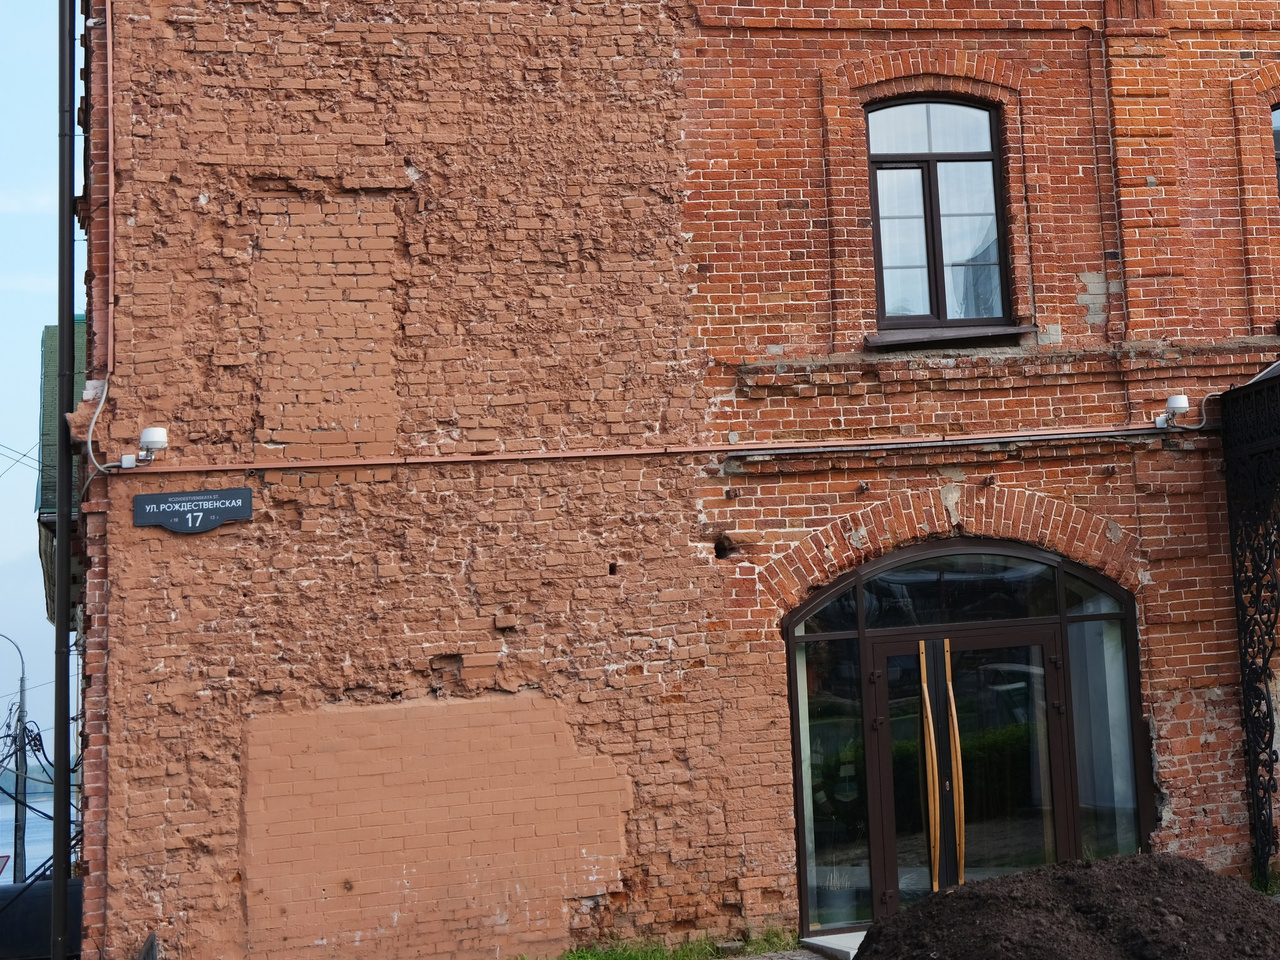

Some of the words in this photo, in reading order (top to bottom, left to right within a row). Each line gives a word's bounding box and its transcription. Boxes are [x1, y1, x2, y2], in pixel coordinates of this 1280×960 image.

[145, 504, 158, 512] УЛ.
[160, 499, 242, 512] РОЖДЕСТВЕНСКАЯ
[185, 512, 204, 527] 17
